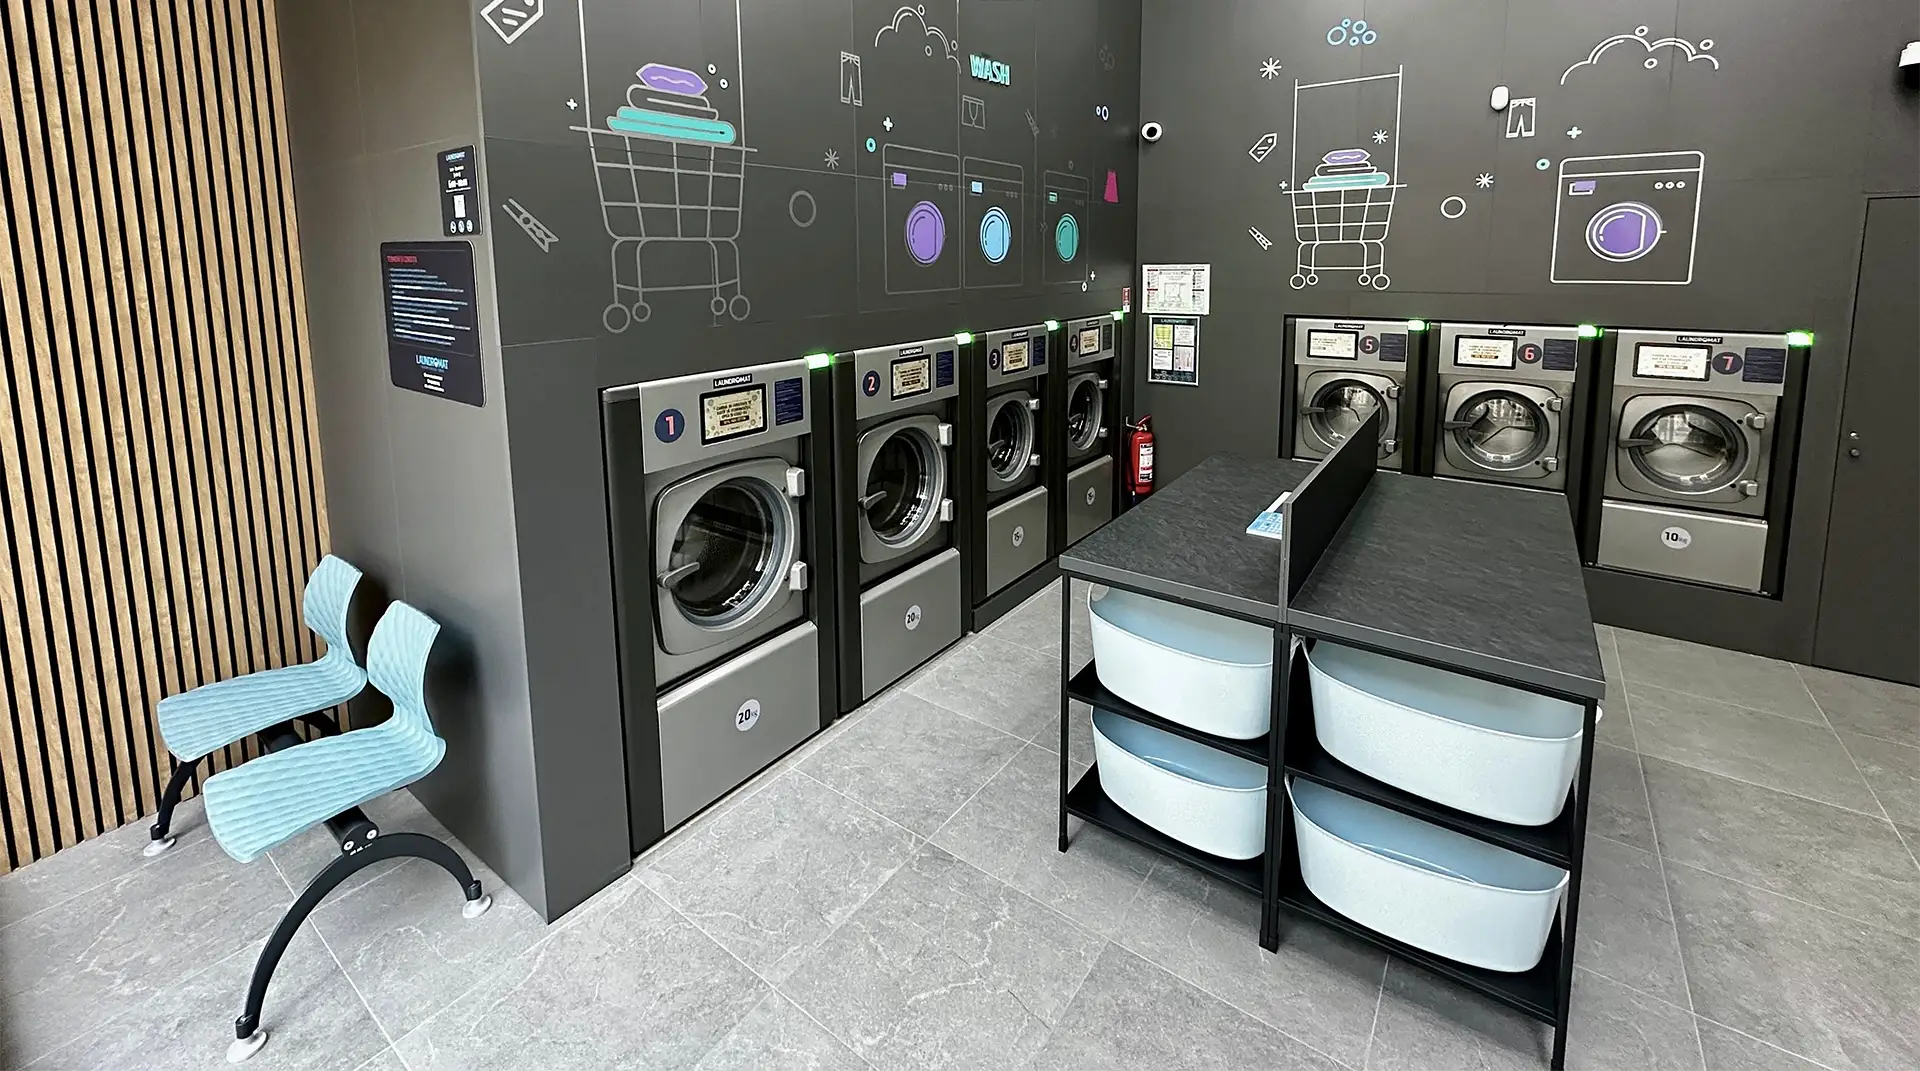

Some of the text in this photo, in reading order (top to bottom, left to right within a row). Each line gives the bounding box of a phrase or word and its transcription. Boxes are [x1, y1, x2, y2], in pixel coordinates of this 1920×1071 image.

[969, 54, 1010, 86] WASH
[1365, 339, 1373, 351] 5
[992, 352, 998, 366] 3
[1524, 347, 1535, 360] 6
[1722, 356, 1734, 371] 7
[714, 374, 752, 387] LAUNDROMAT
[868, 376, 876, 392] 2
[665, 415, 675, 436] 1
